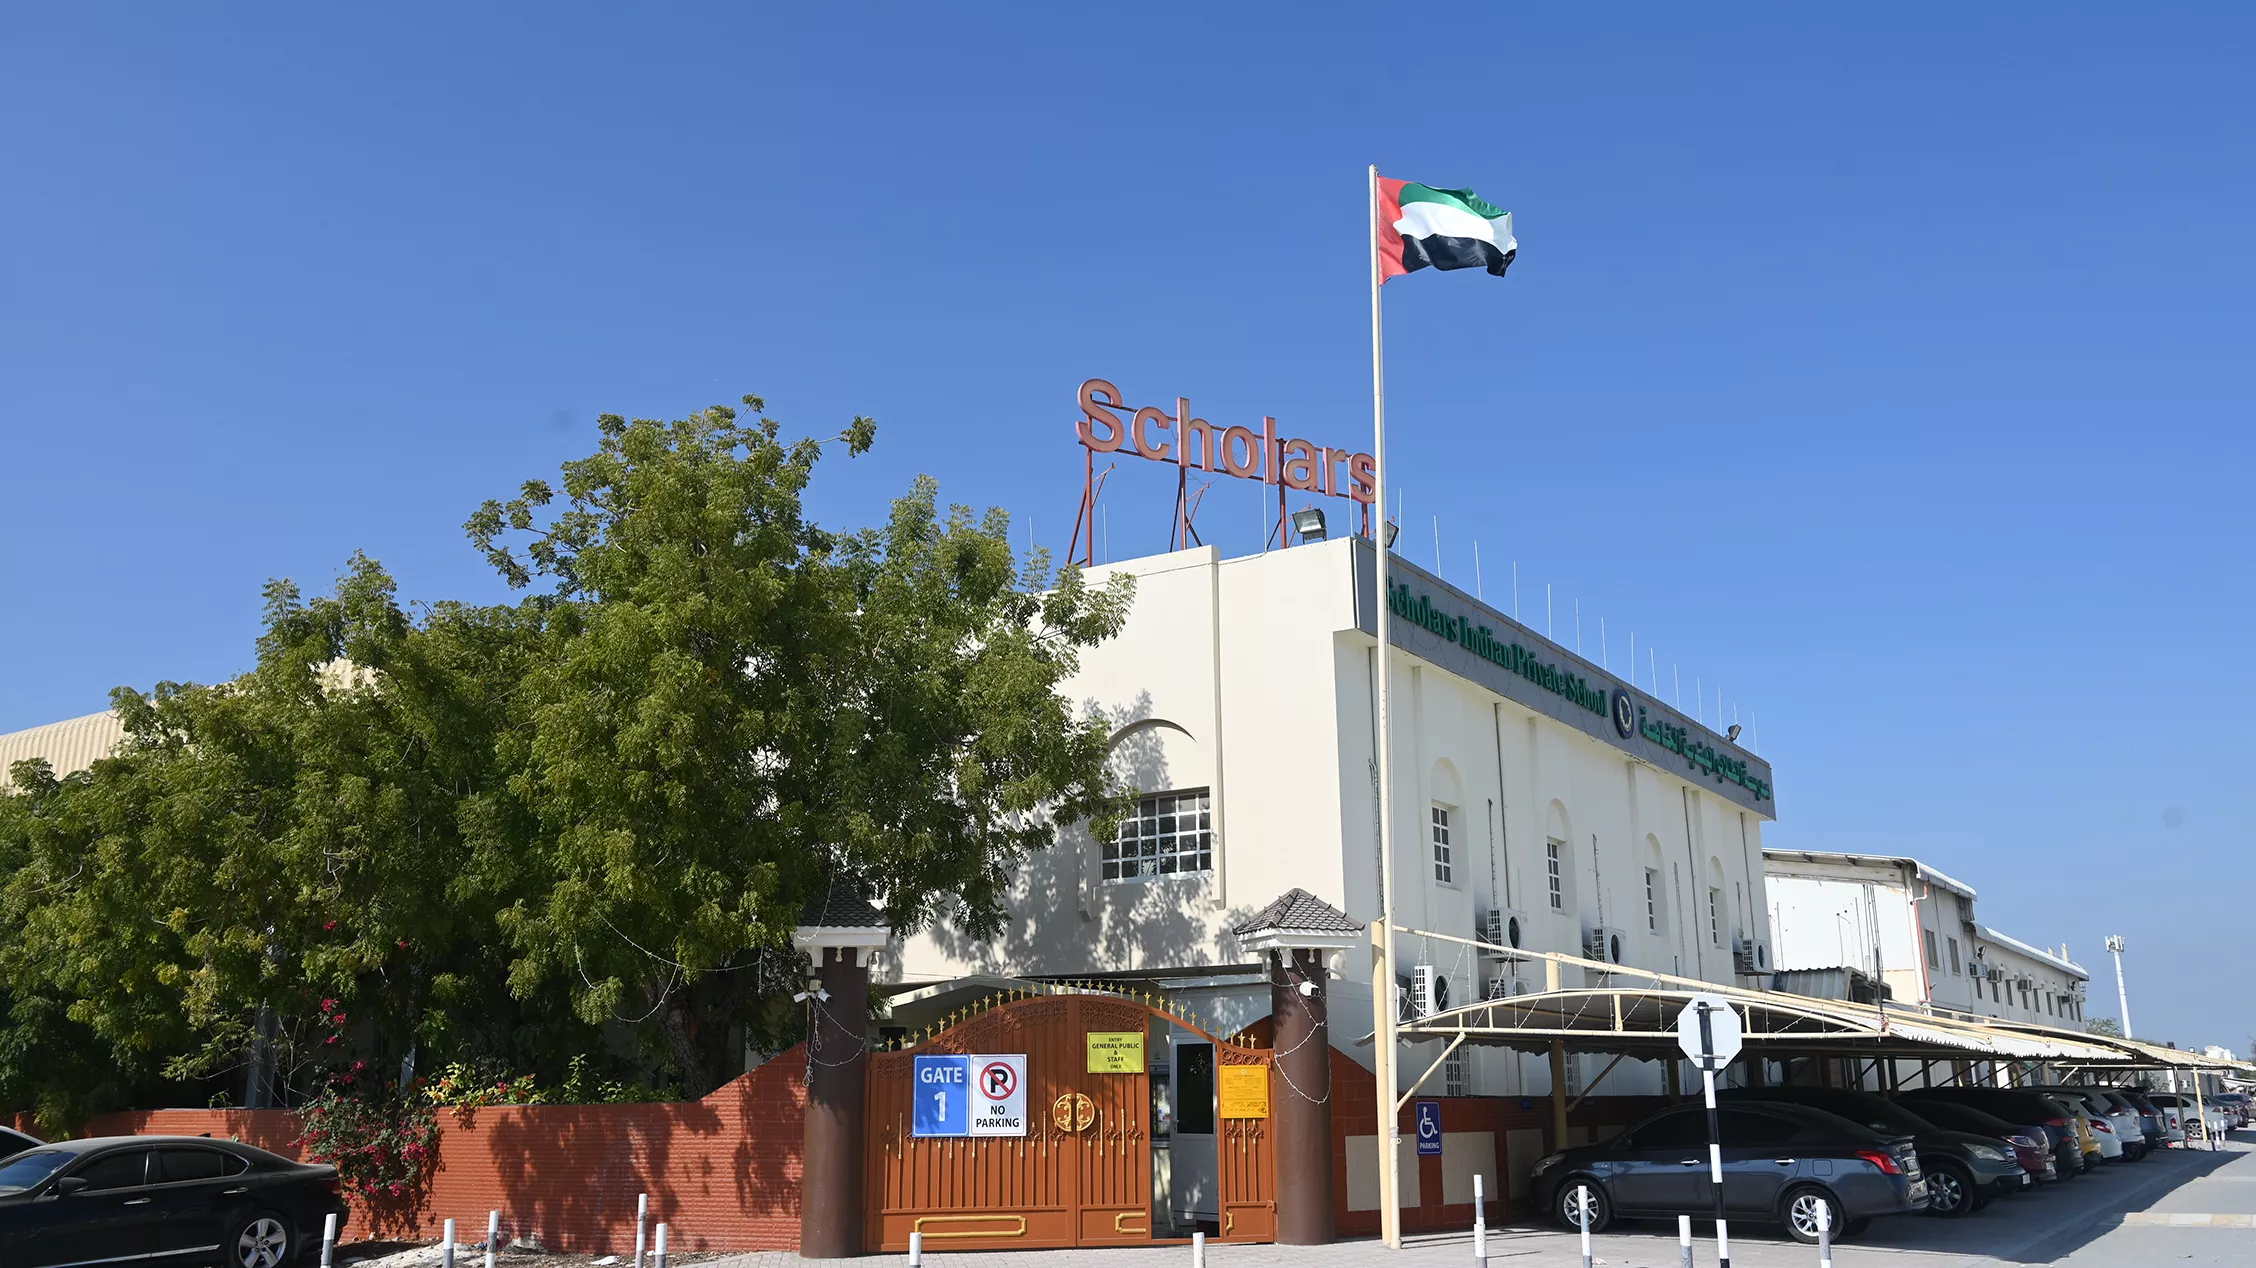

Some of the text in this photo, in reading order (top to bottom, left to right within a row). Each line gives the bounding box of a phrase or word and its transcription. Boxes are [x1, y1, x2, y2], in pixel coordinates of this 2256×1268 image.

[1075, 378, 1376, 504] Scholars
[1457, 615, 1512, 670] Indian
[1511, 643, 1565, 695] Private
[1564, 672, 1608, 718] School
[920, 1067, 963, 1084] GATE
[934, 1091, 946, 1122] 1
[990, 1105, 1006, 1116] NO
[976, 1117, 1020, 1129] PARKING
[1419, 1142, 1440, 1150] PARKING
